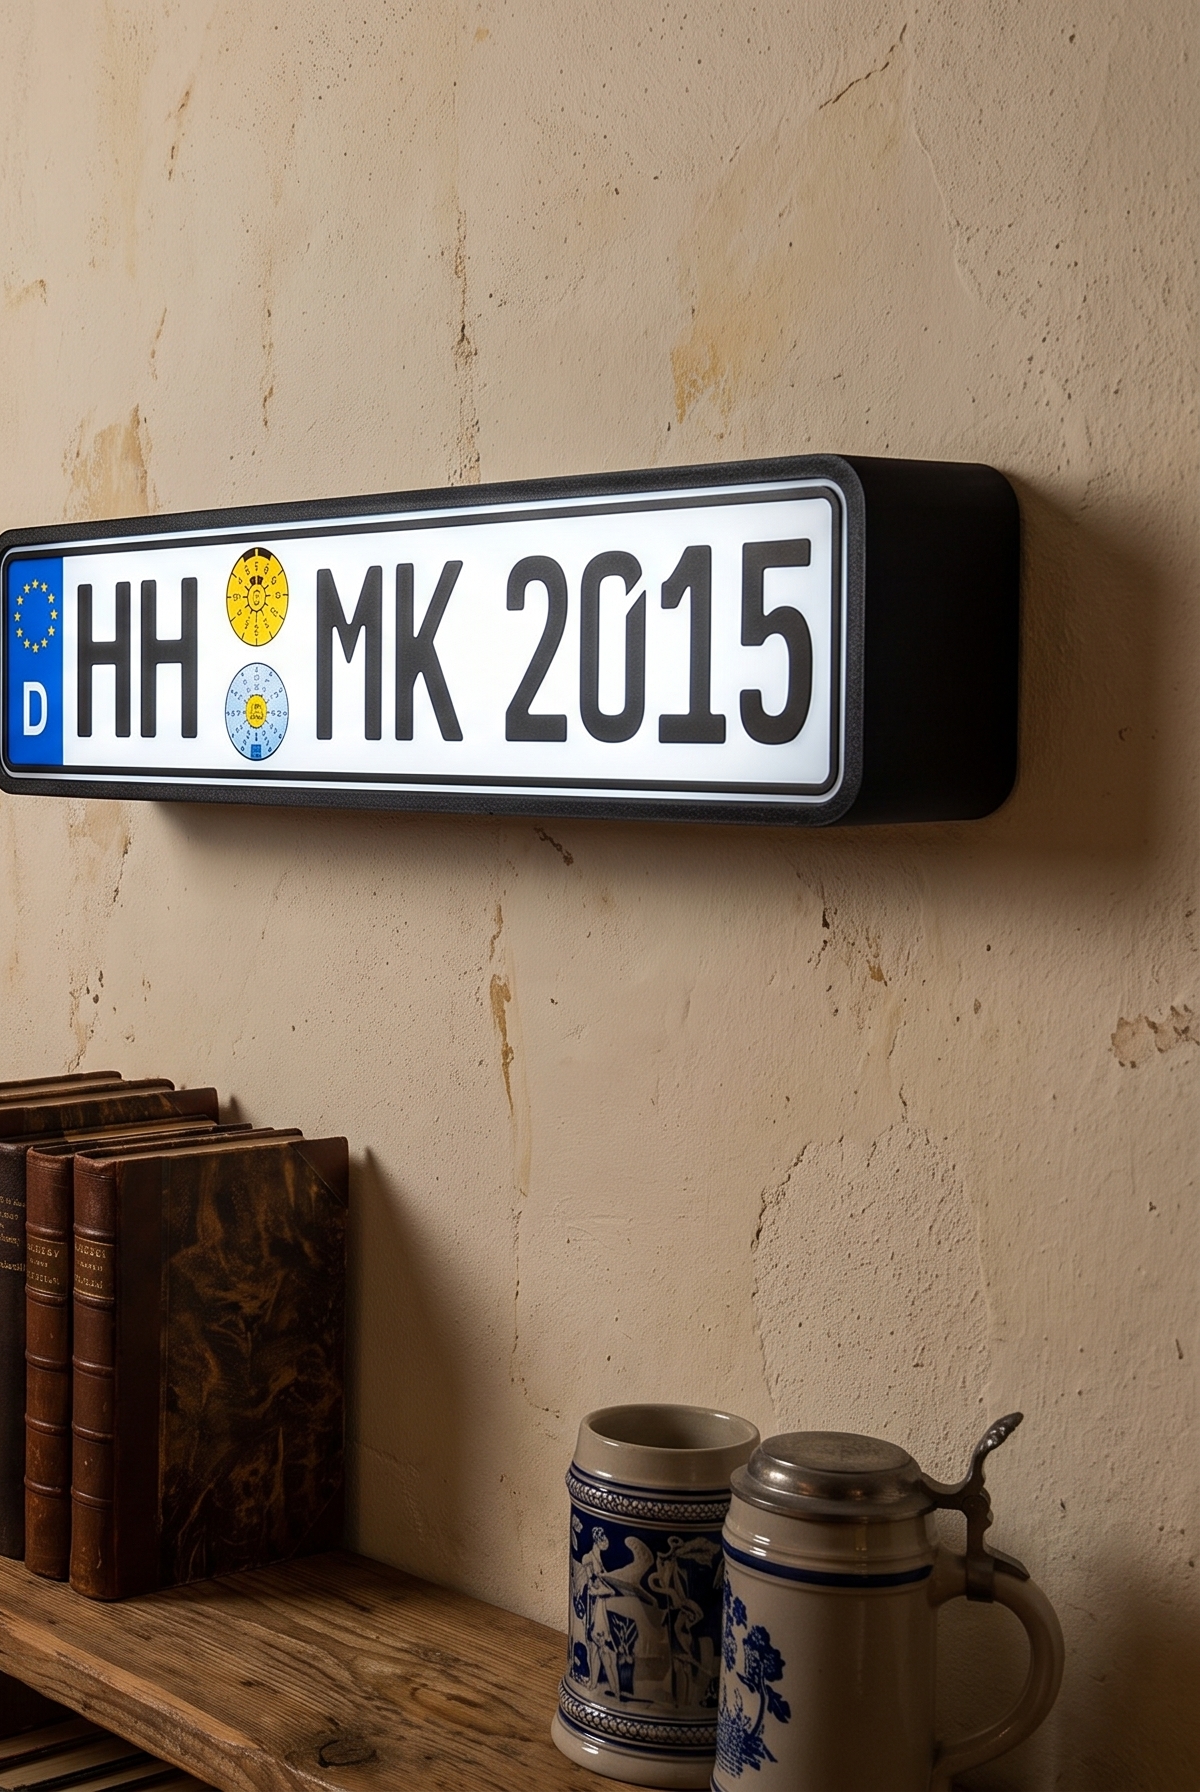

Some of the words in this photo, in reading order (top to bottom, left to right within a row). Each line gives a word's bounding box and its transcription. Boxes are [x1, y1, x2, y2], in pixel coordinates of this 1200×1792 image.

[77, 577, 197, 738] HH
[317, 561, 463, 741] MK
[506, 538, 813, 745] 2015
[23, 681, 48, 736] D
